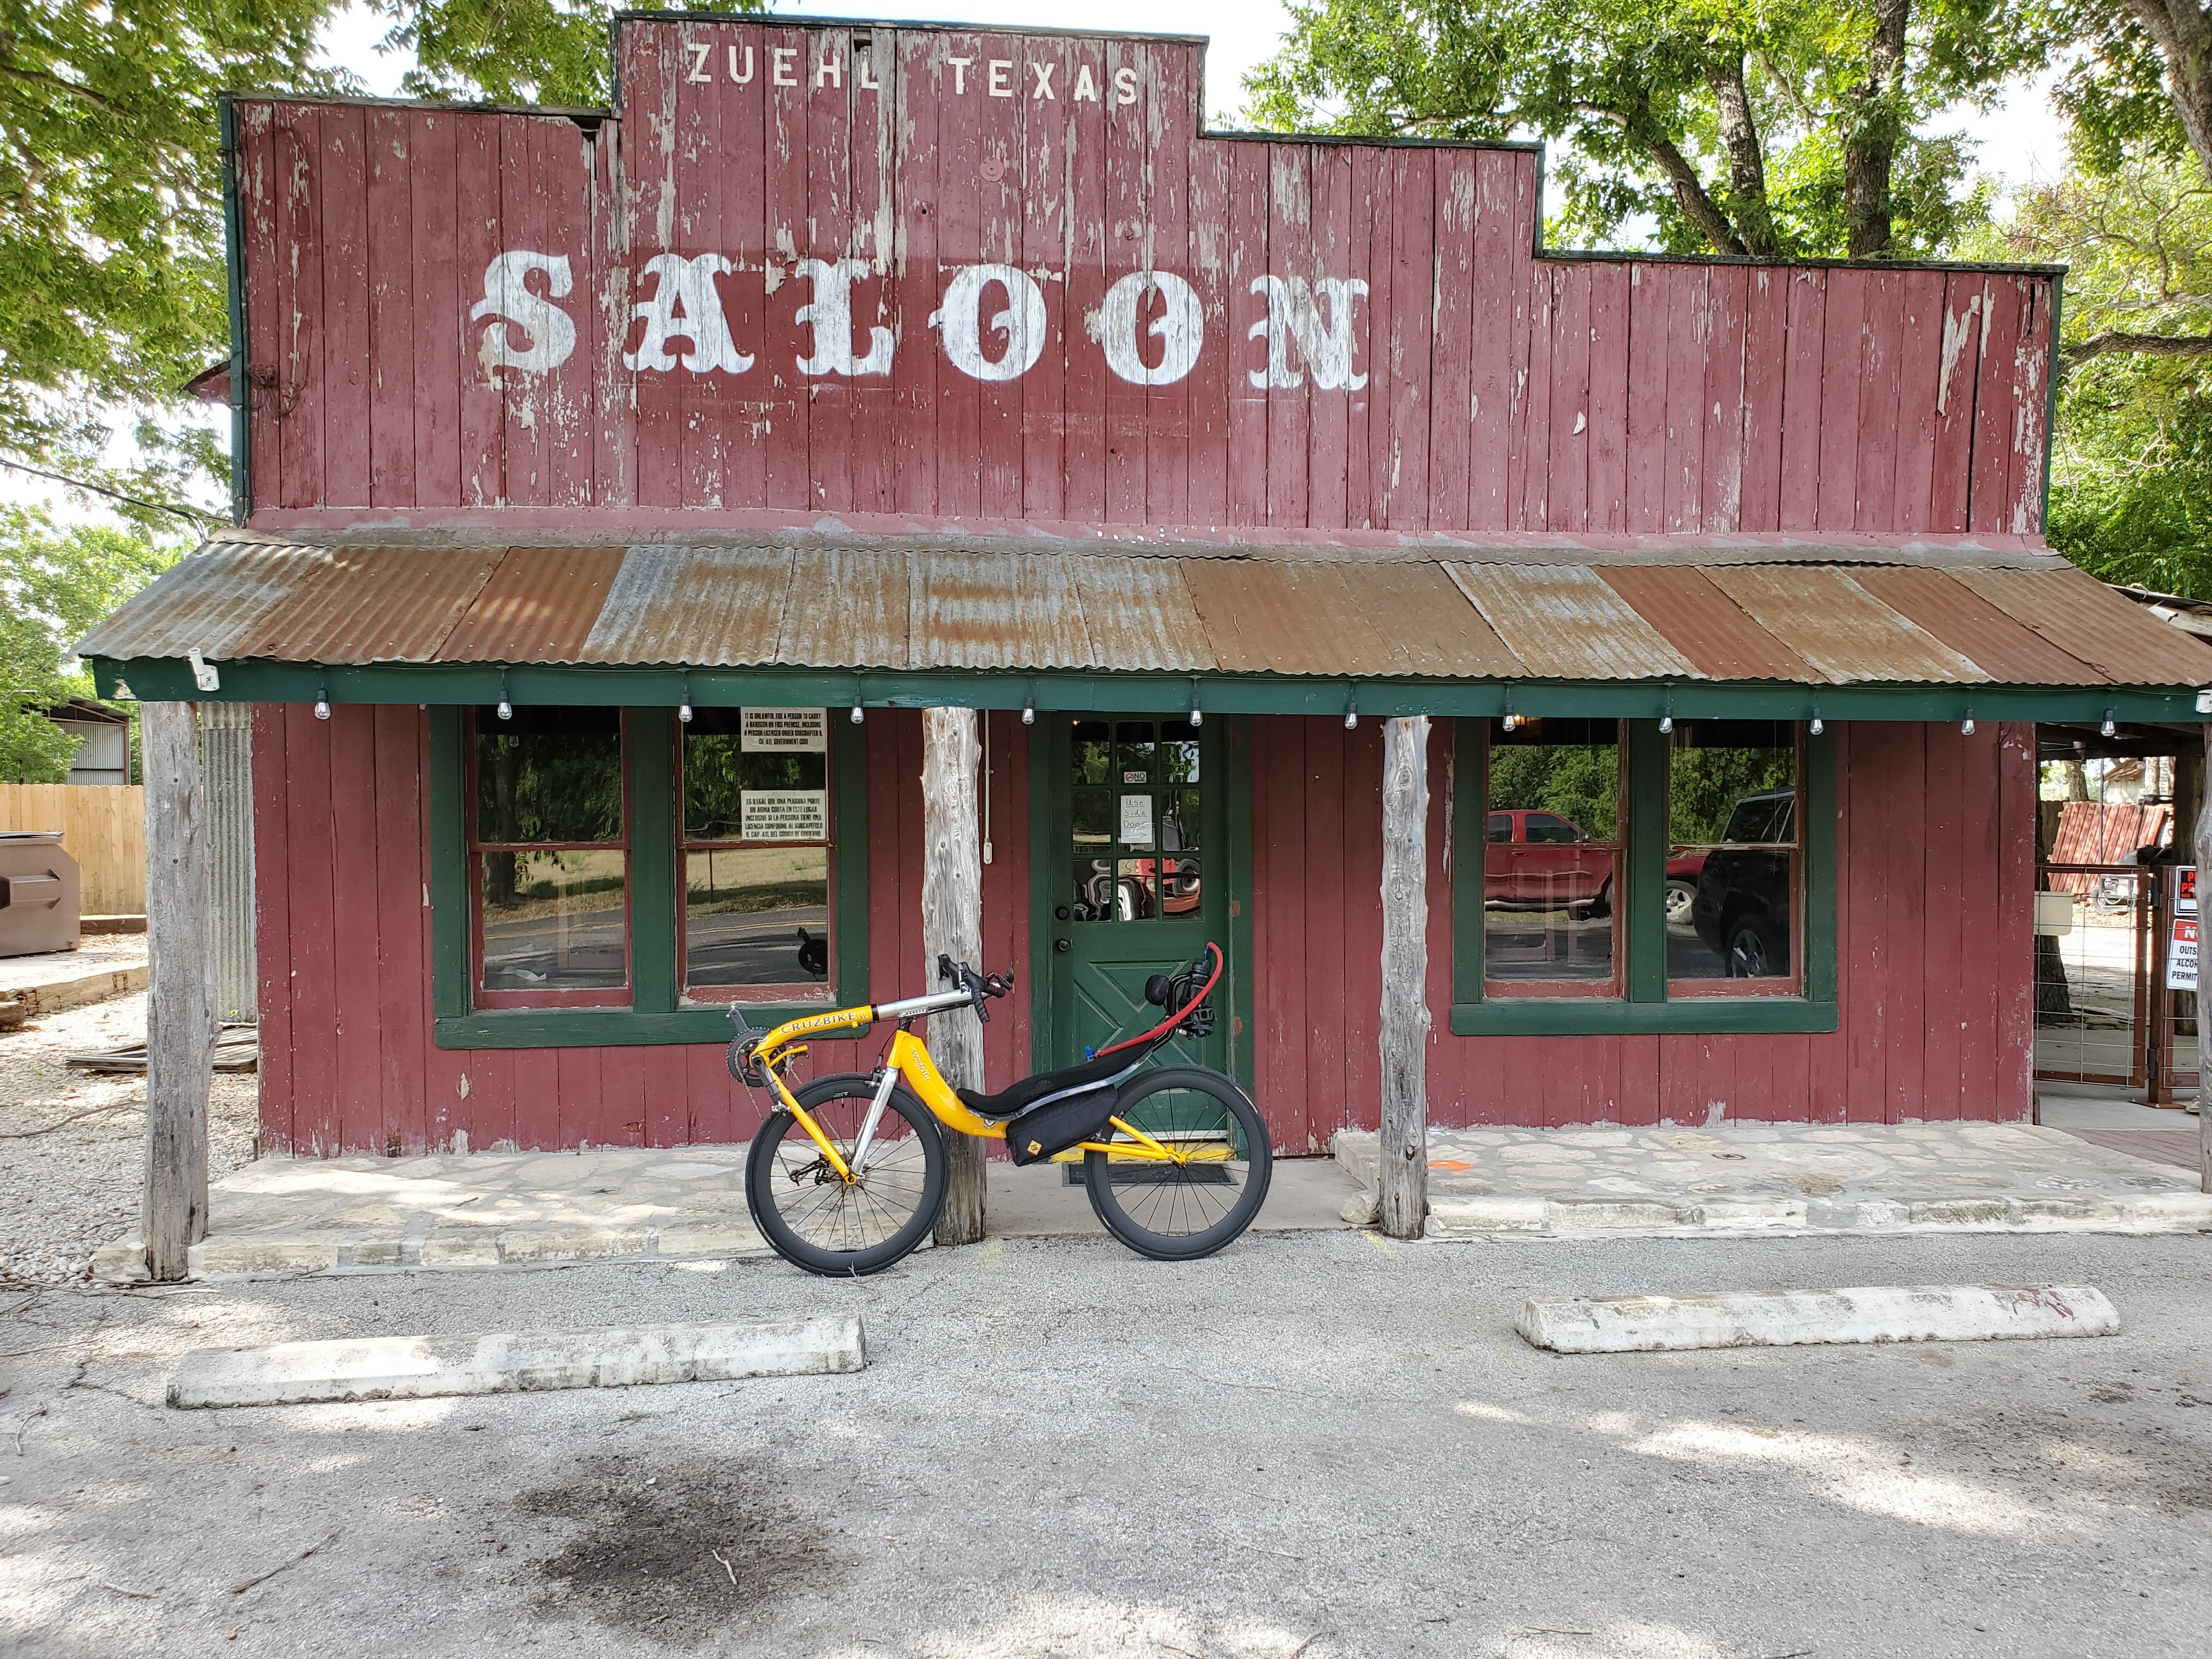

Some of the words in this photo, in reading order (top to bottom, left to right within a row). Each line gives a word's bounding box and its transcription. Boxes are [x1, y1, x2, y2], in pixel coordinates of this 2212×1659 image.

[686, 43, 879, 90] ZUEHL
[947, 57, 1138, 104] TEXAS
[471, 250, 1370, 391] SALOON
[1126, 798, 1144, 806] Use
[2180, 945, 2198, 955] OUTS
[2176, 959, 2198, 968] ALCOH
[2171, 970, 2198, 981] PERMIT
[781, 1012, 857, 1034] CRUZBIKE
